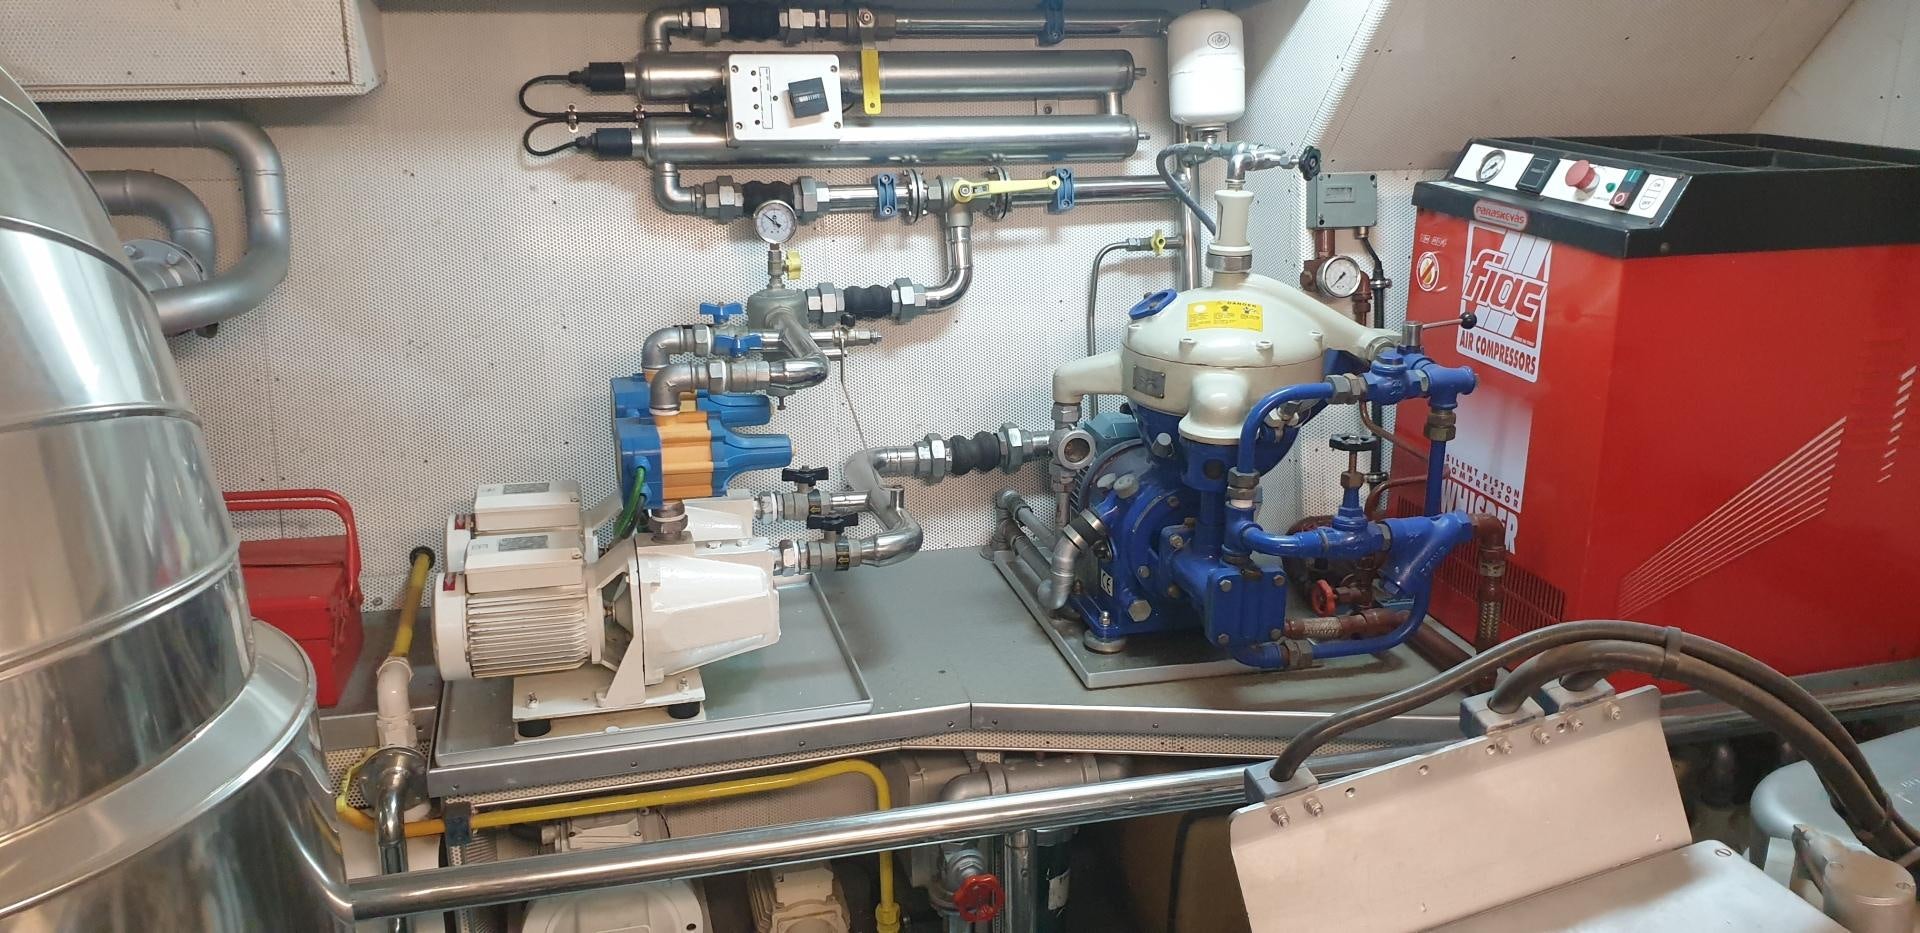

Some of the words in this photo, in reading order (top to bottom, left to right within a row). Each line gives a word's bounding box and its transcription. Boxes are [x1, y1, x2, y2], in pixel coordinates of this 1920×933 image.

[1463, 250, 1547, 321] fiac
[1460, 330, 1473, 351] AIR
[1476, 335, 1536, 375] COMPRESSORS
[1446, 454, 1478, 477] SILENT
[1483, 473, 1519, 498] PISTON
[1448, 466, 1519, 508] OMPRESSOR
